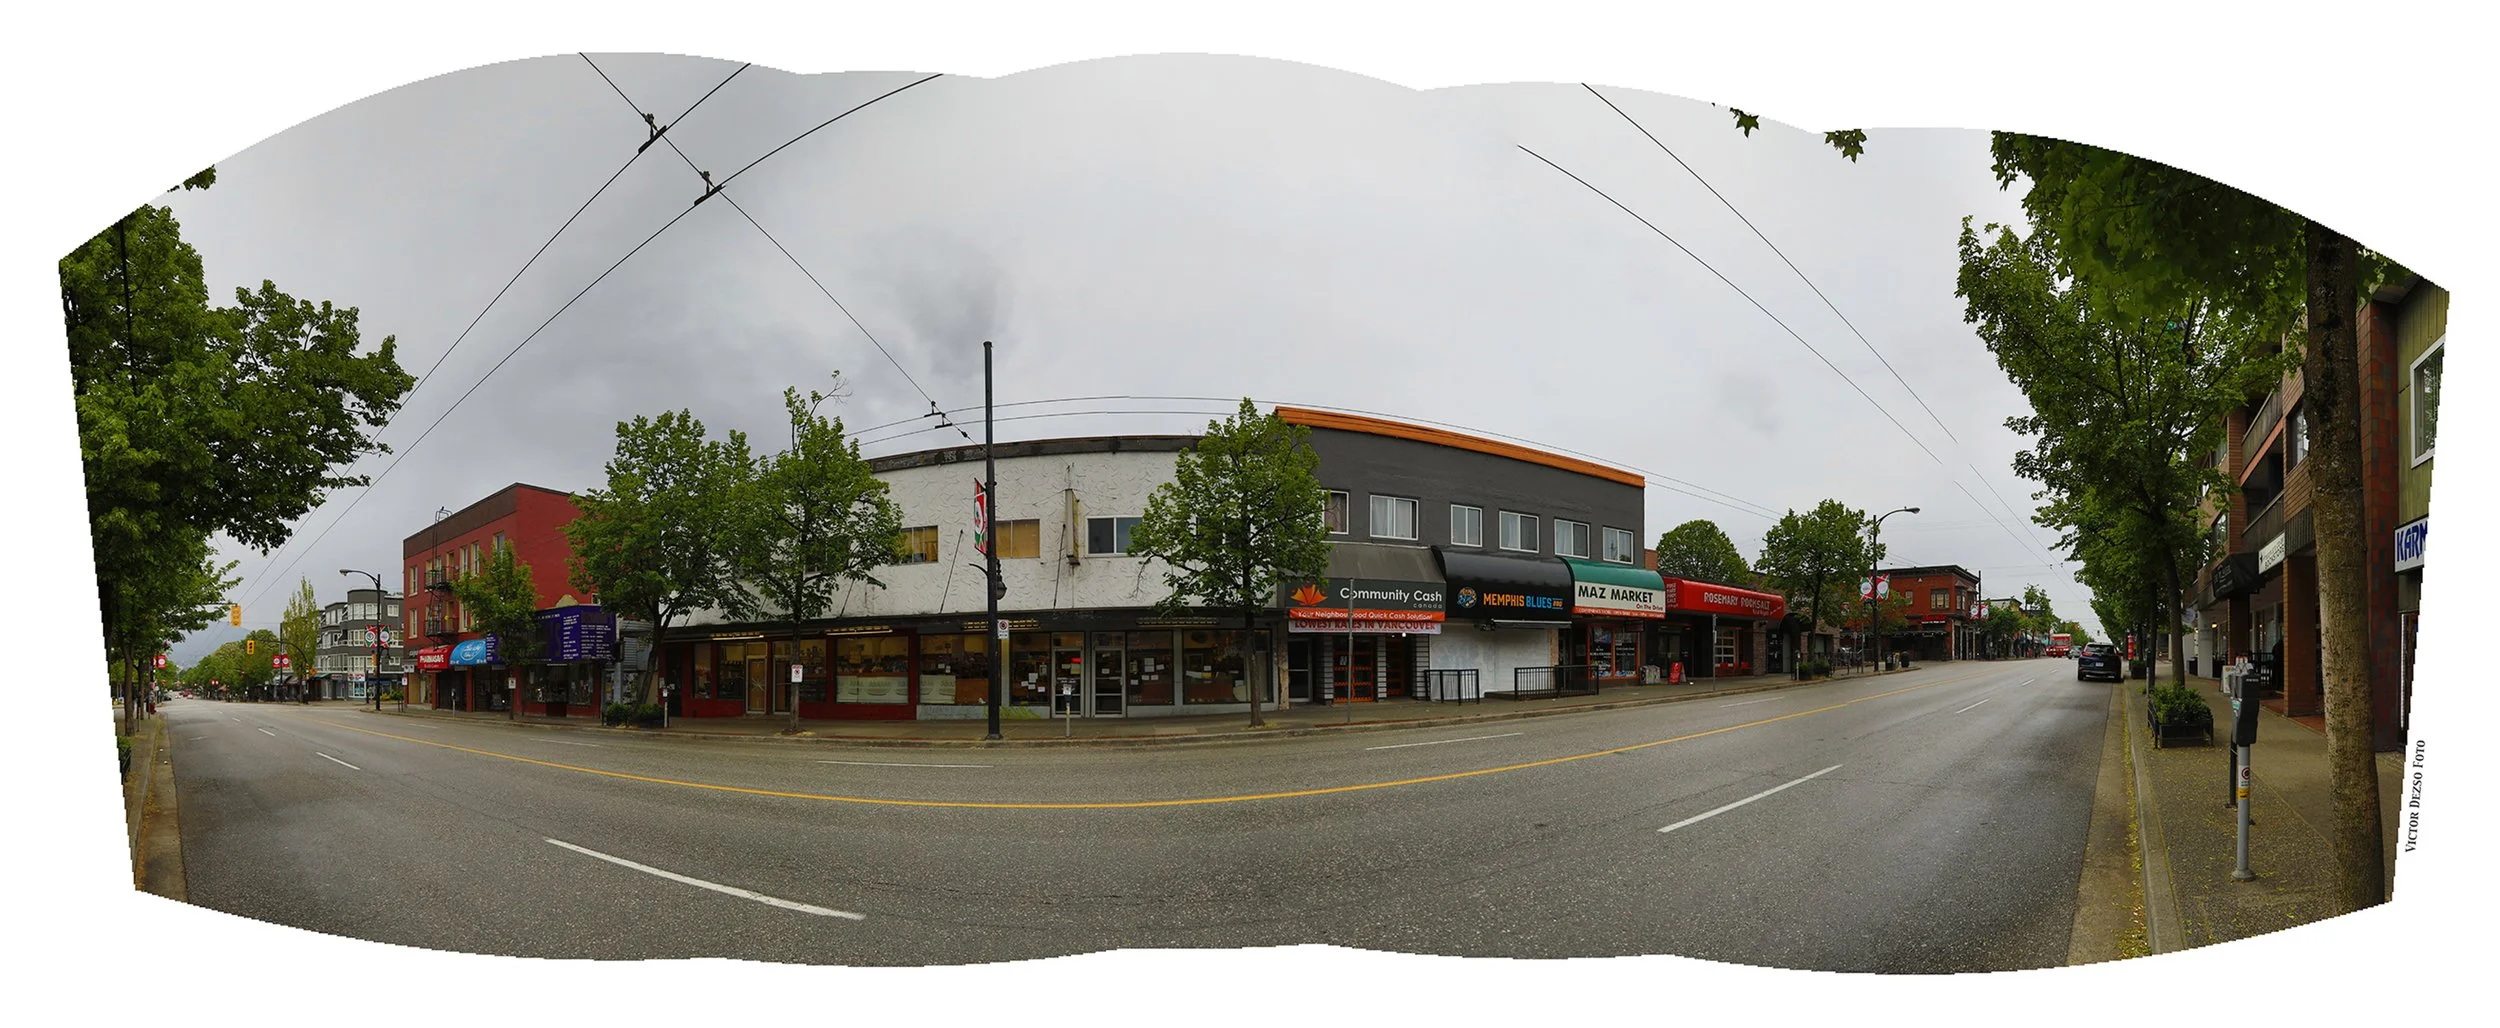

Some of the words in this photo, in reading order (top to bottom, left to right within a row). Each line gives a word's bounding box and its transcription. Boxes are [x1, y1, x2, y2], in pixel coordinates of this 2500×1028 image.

[1340, 588, 1410, 603] Community
[1414, 590, 1442, 601] Cash
[1483, 592, 1525, 606] MEMPHIS
[1526, 595, 1552, 608] BLUES
[1578, 585, 1606, 599] MAZ
[1610, 588, 1653, 603] MARKET
[1704, 592, 1738, 606] ROSEMARY
[1740, 598, 1770, 609] ROCKSALT
[1295, 620, 1333, 629] LOWEST
[1335, 620, 1362, 629] RAES
[1365, 621, 1374, 629] IN
[1376, 621, 1436, 630] VANCOUVER
